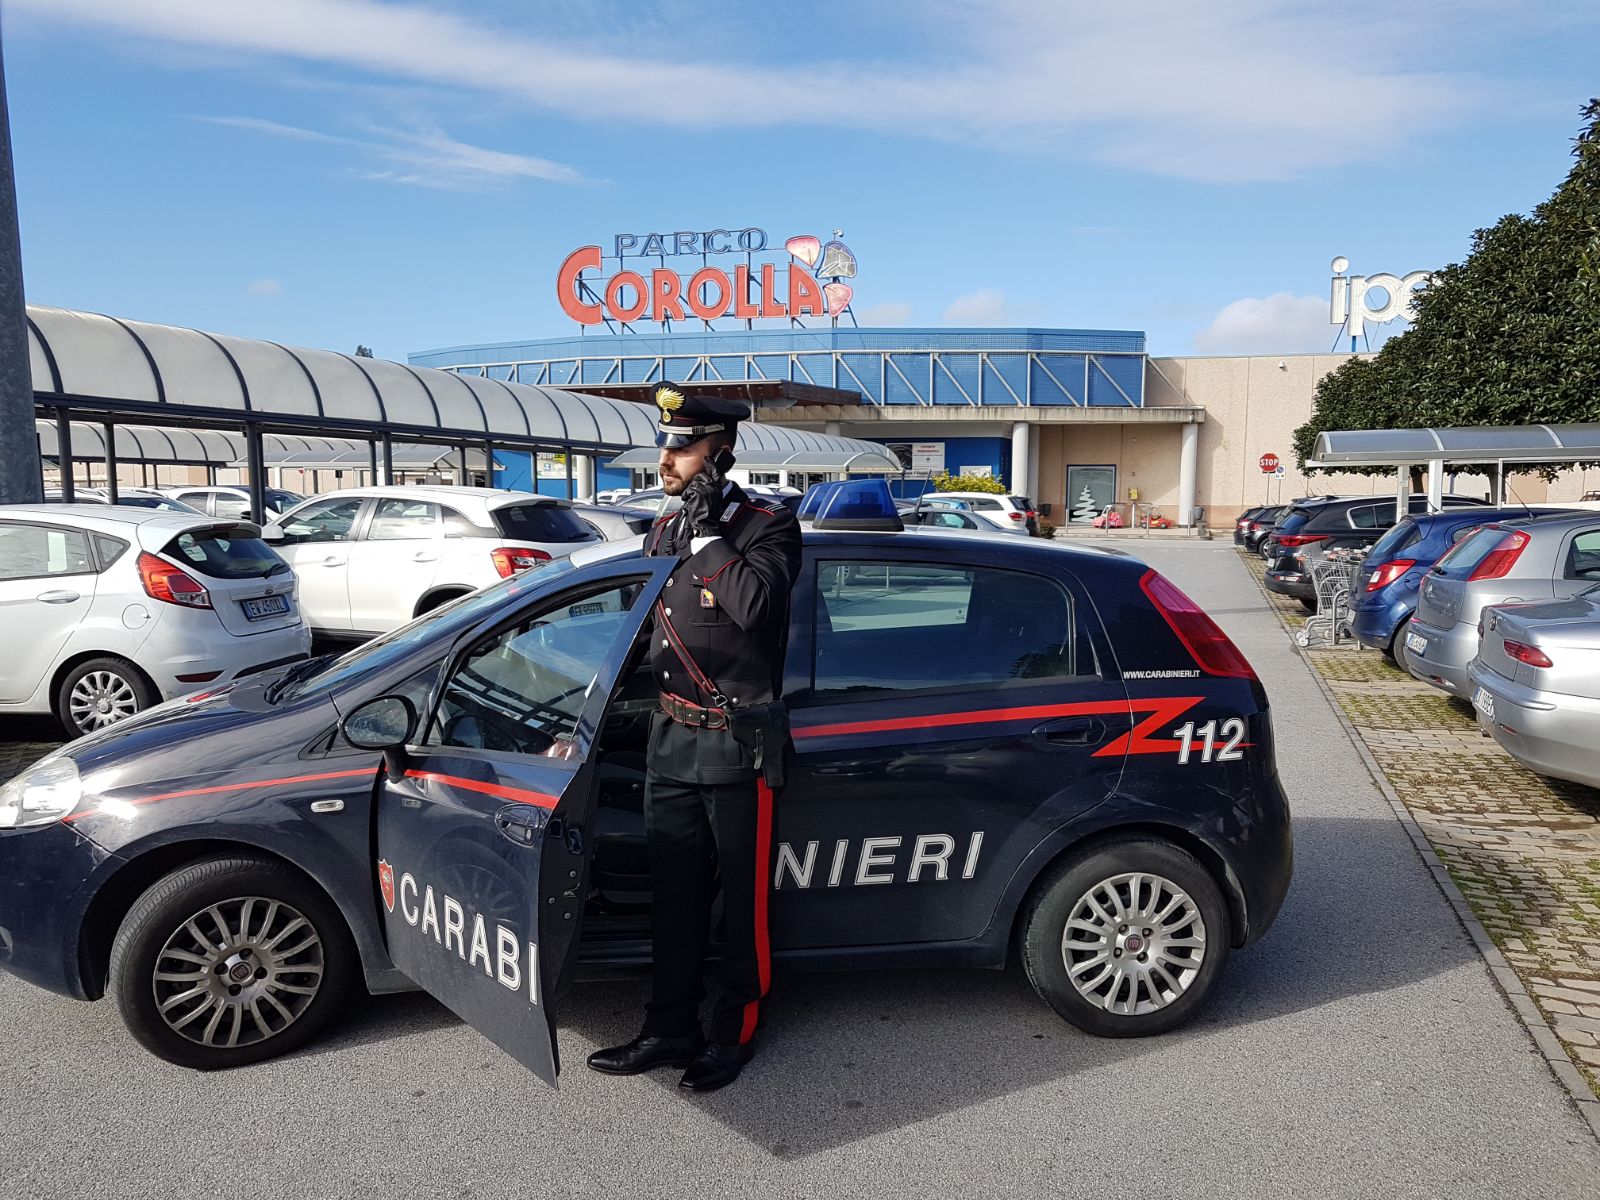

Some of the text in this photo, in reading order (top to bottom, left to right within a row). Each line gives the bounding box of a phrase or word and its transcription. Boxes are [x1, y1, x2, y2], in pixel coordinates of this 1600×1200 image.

[614, 227, 768, 258] PARCO
[556, 245, 824, 325] COROLLA
[1260, 458, 1280, 466] STOP
[1123, 669, 1201, 679] WWW.CARABINIERI.IT
[1173, 717, 1245, 765] 112
[774, 831, 985, 889] NIERI
[400, 872, 538, 1005] CARABI
